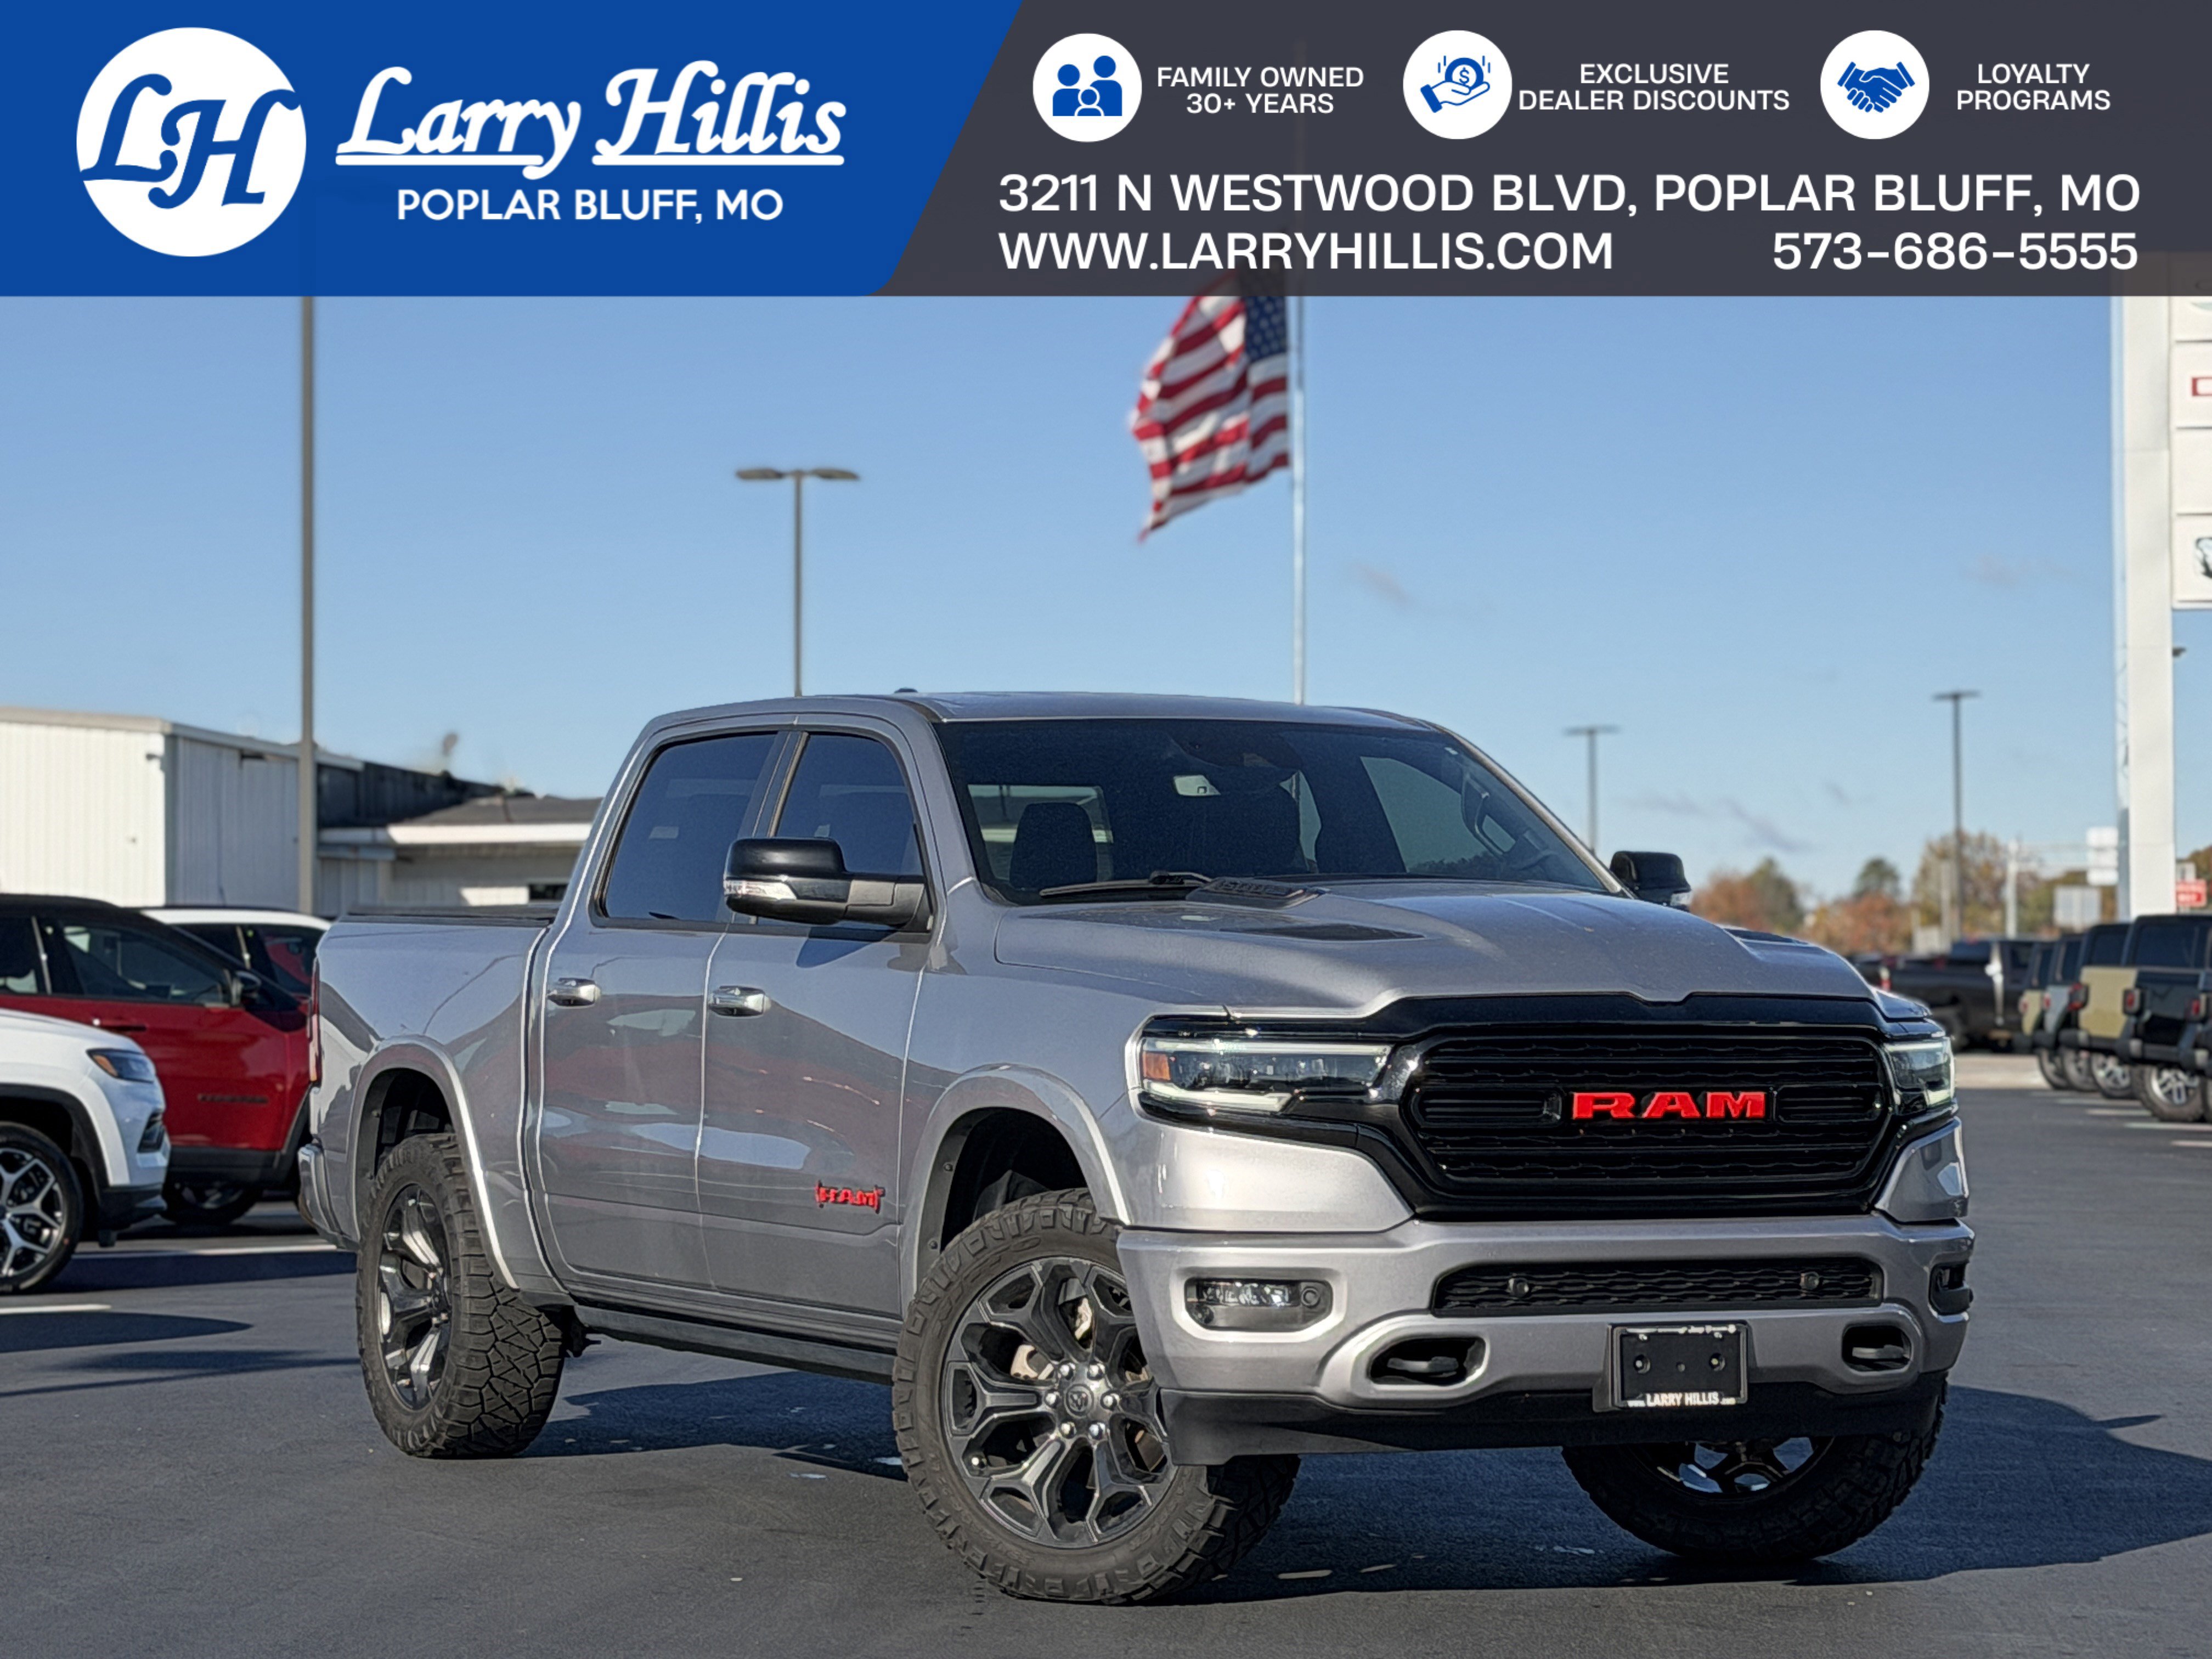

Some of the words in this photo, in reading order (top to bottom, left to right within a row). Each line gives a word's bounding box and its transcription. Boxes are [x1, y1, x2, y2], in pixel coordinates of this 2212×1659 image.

[1572, 1091, 1765, 1119] RAM
[1646, 1392, 1682, 1407] LARRY
[1685, 1391, 1719, 1406] HILLIS
